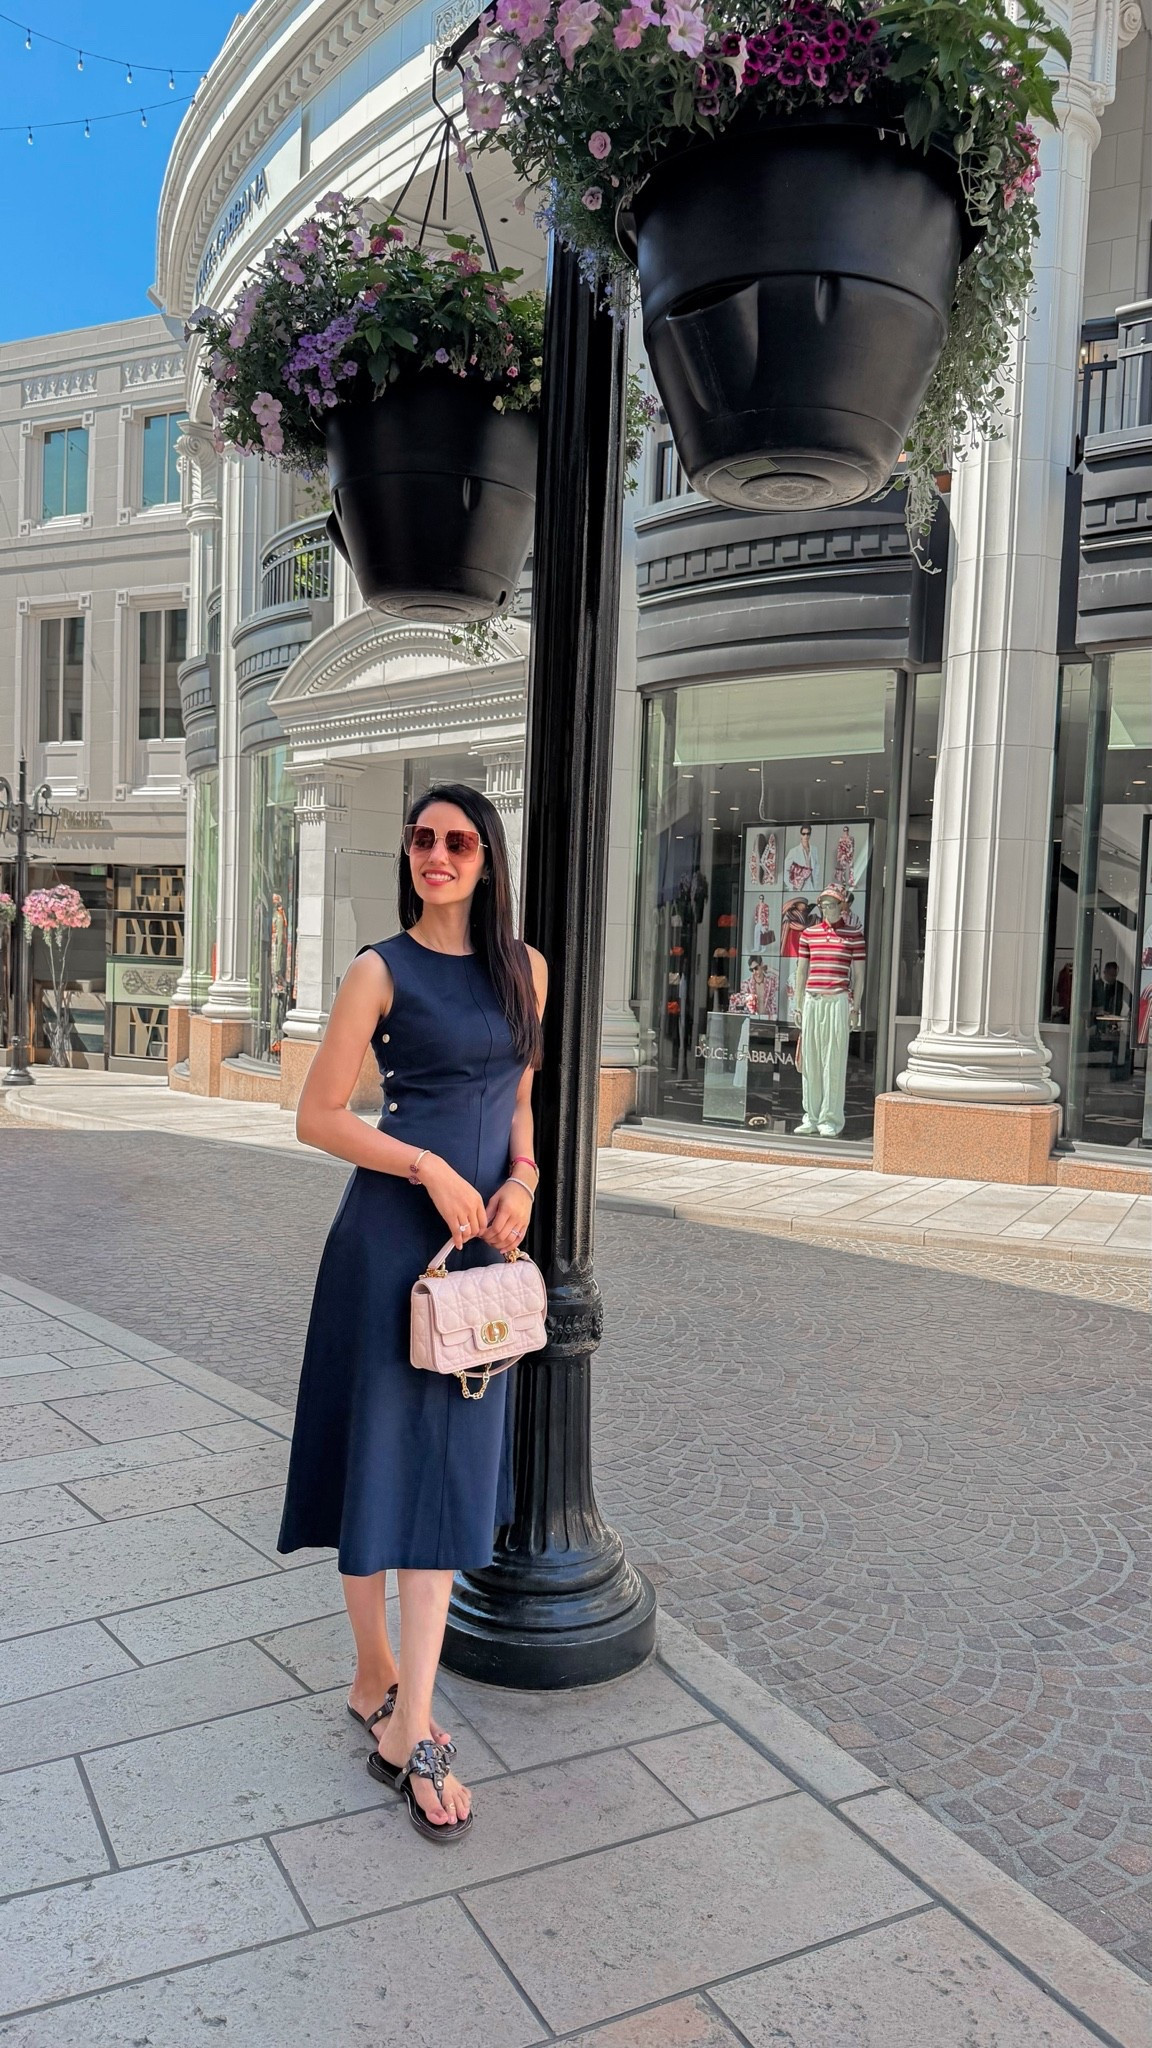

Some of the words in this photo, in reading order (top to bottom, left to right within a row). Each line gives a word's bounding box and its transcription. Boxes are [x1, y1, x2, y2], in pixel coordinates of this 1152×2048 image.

[216, 167, 269, 257] GABBANA
[694, 1045, 729, 1060] DOLCE
[728, 1053, 735, 1061] &
[736, 1050, 795, 1066] GABBANA
